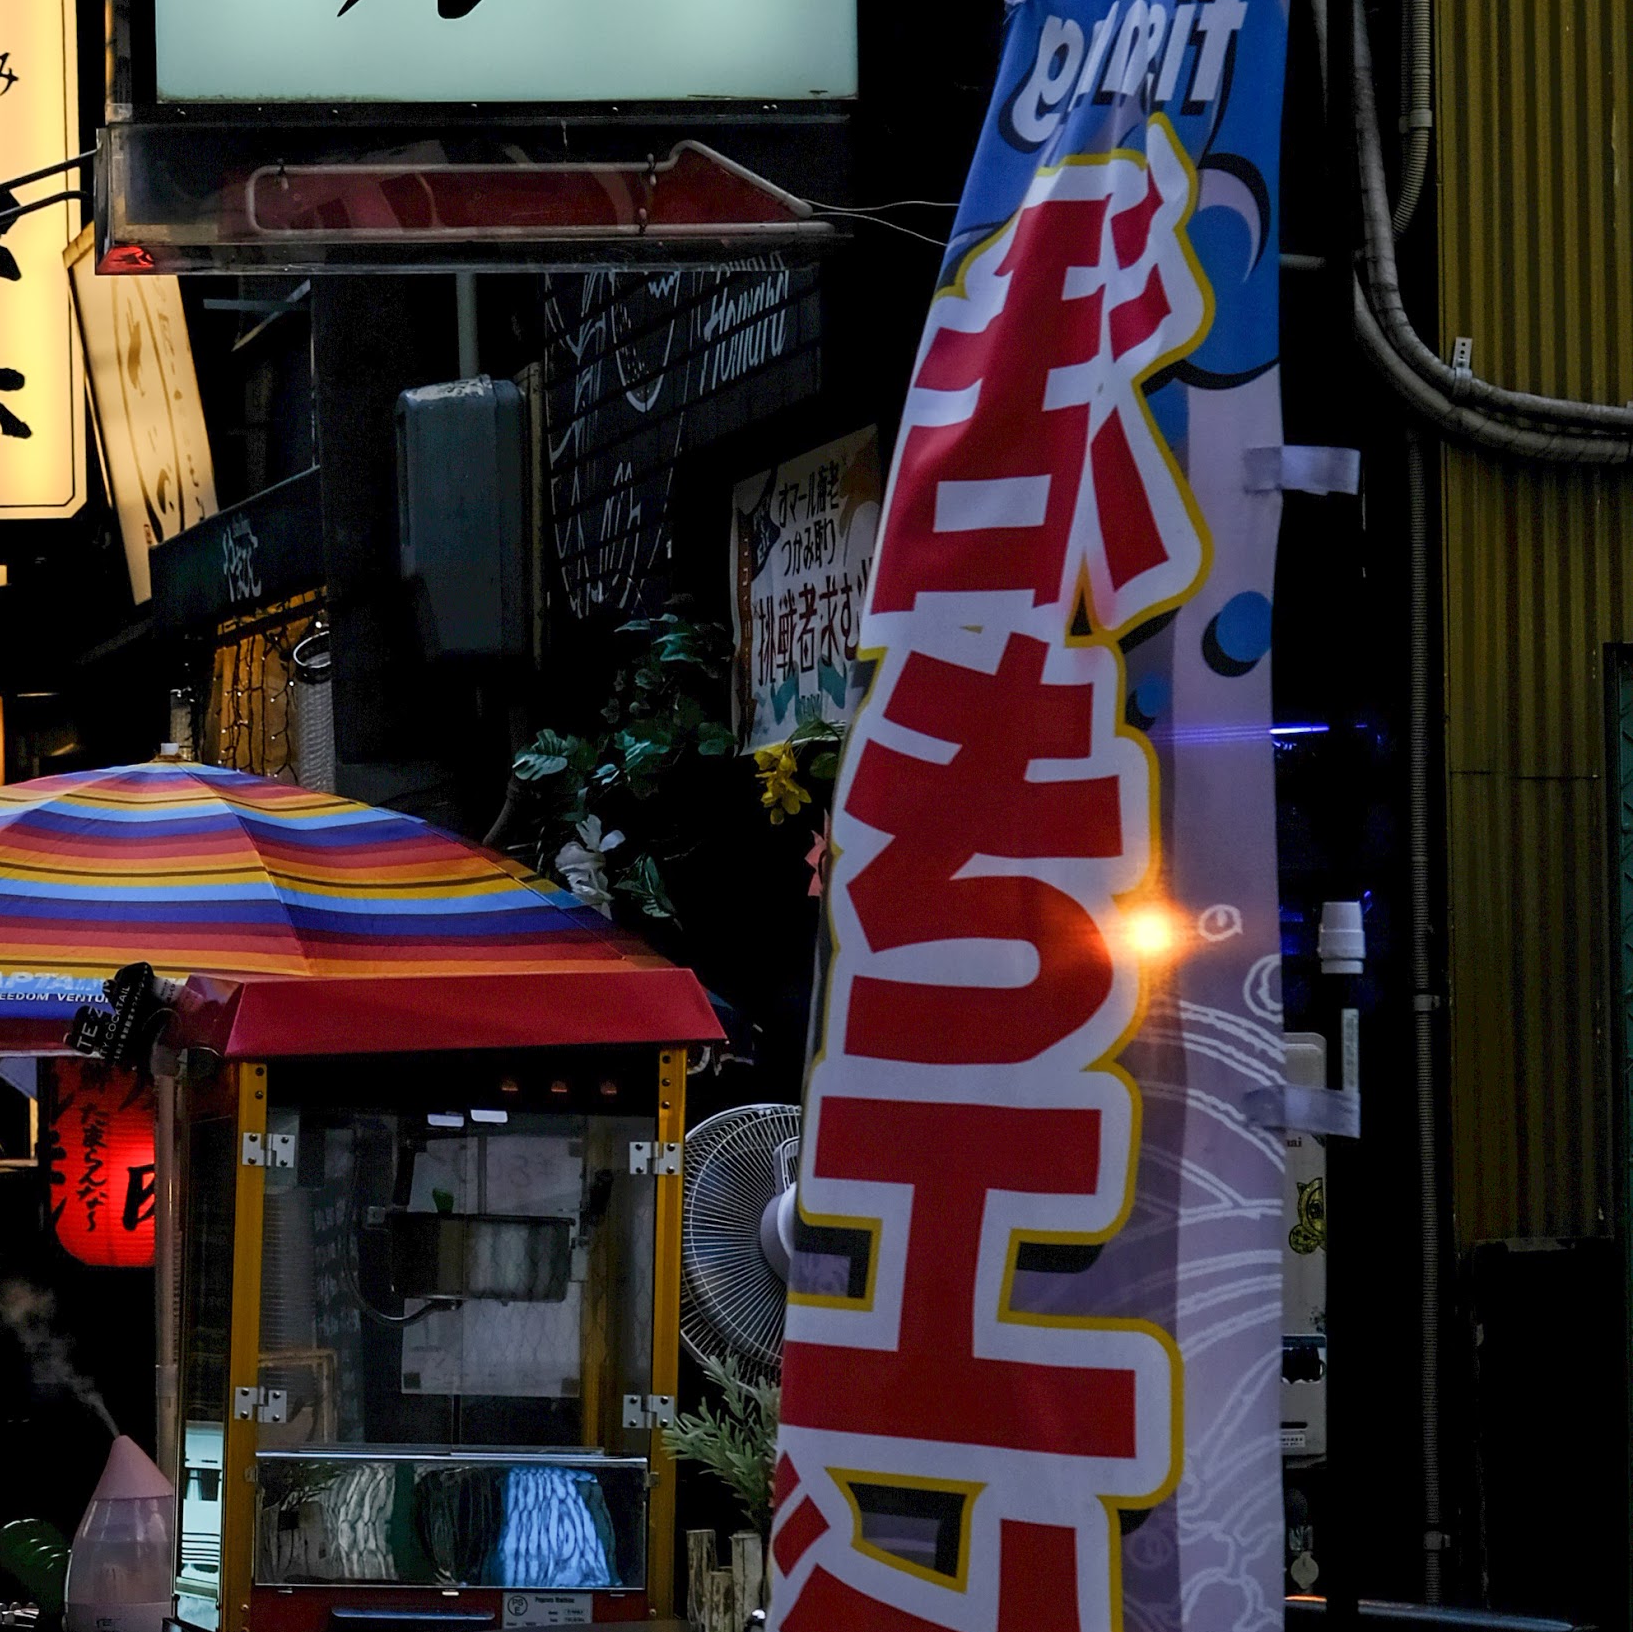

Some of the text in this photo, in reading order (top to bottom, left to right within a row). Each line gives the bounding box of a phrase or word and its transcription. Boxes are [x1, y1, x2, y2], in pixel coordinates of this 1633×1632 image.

[781, 518, 836, 576] つかみ取り
